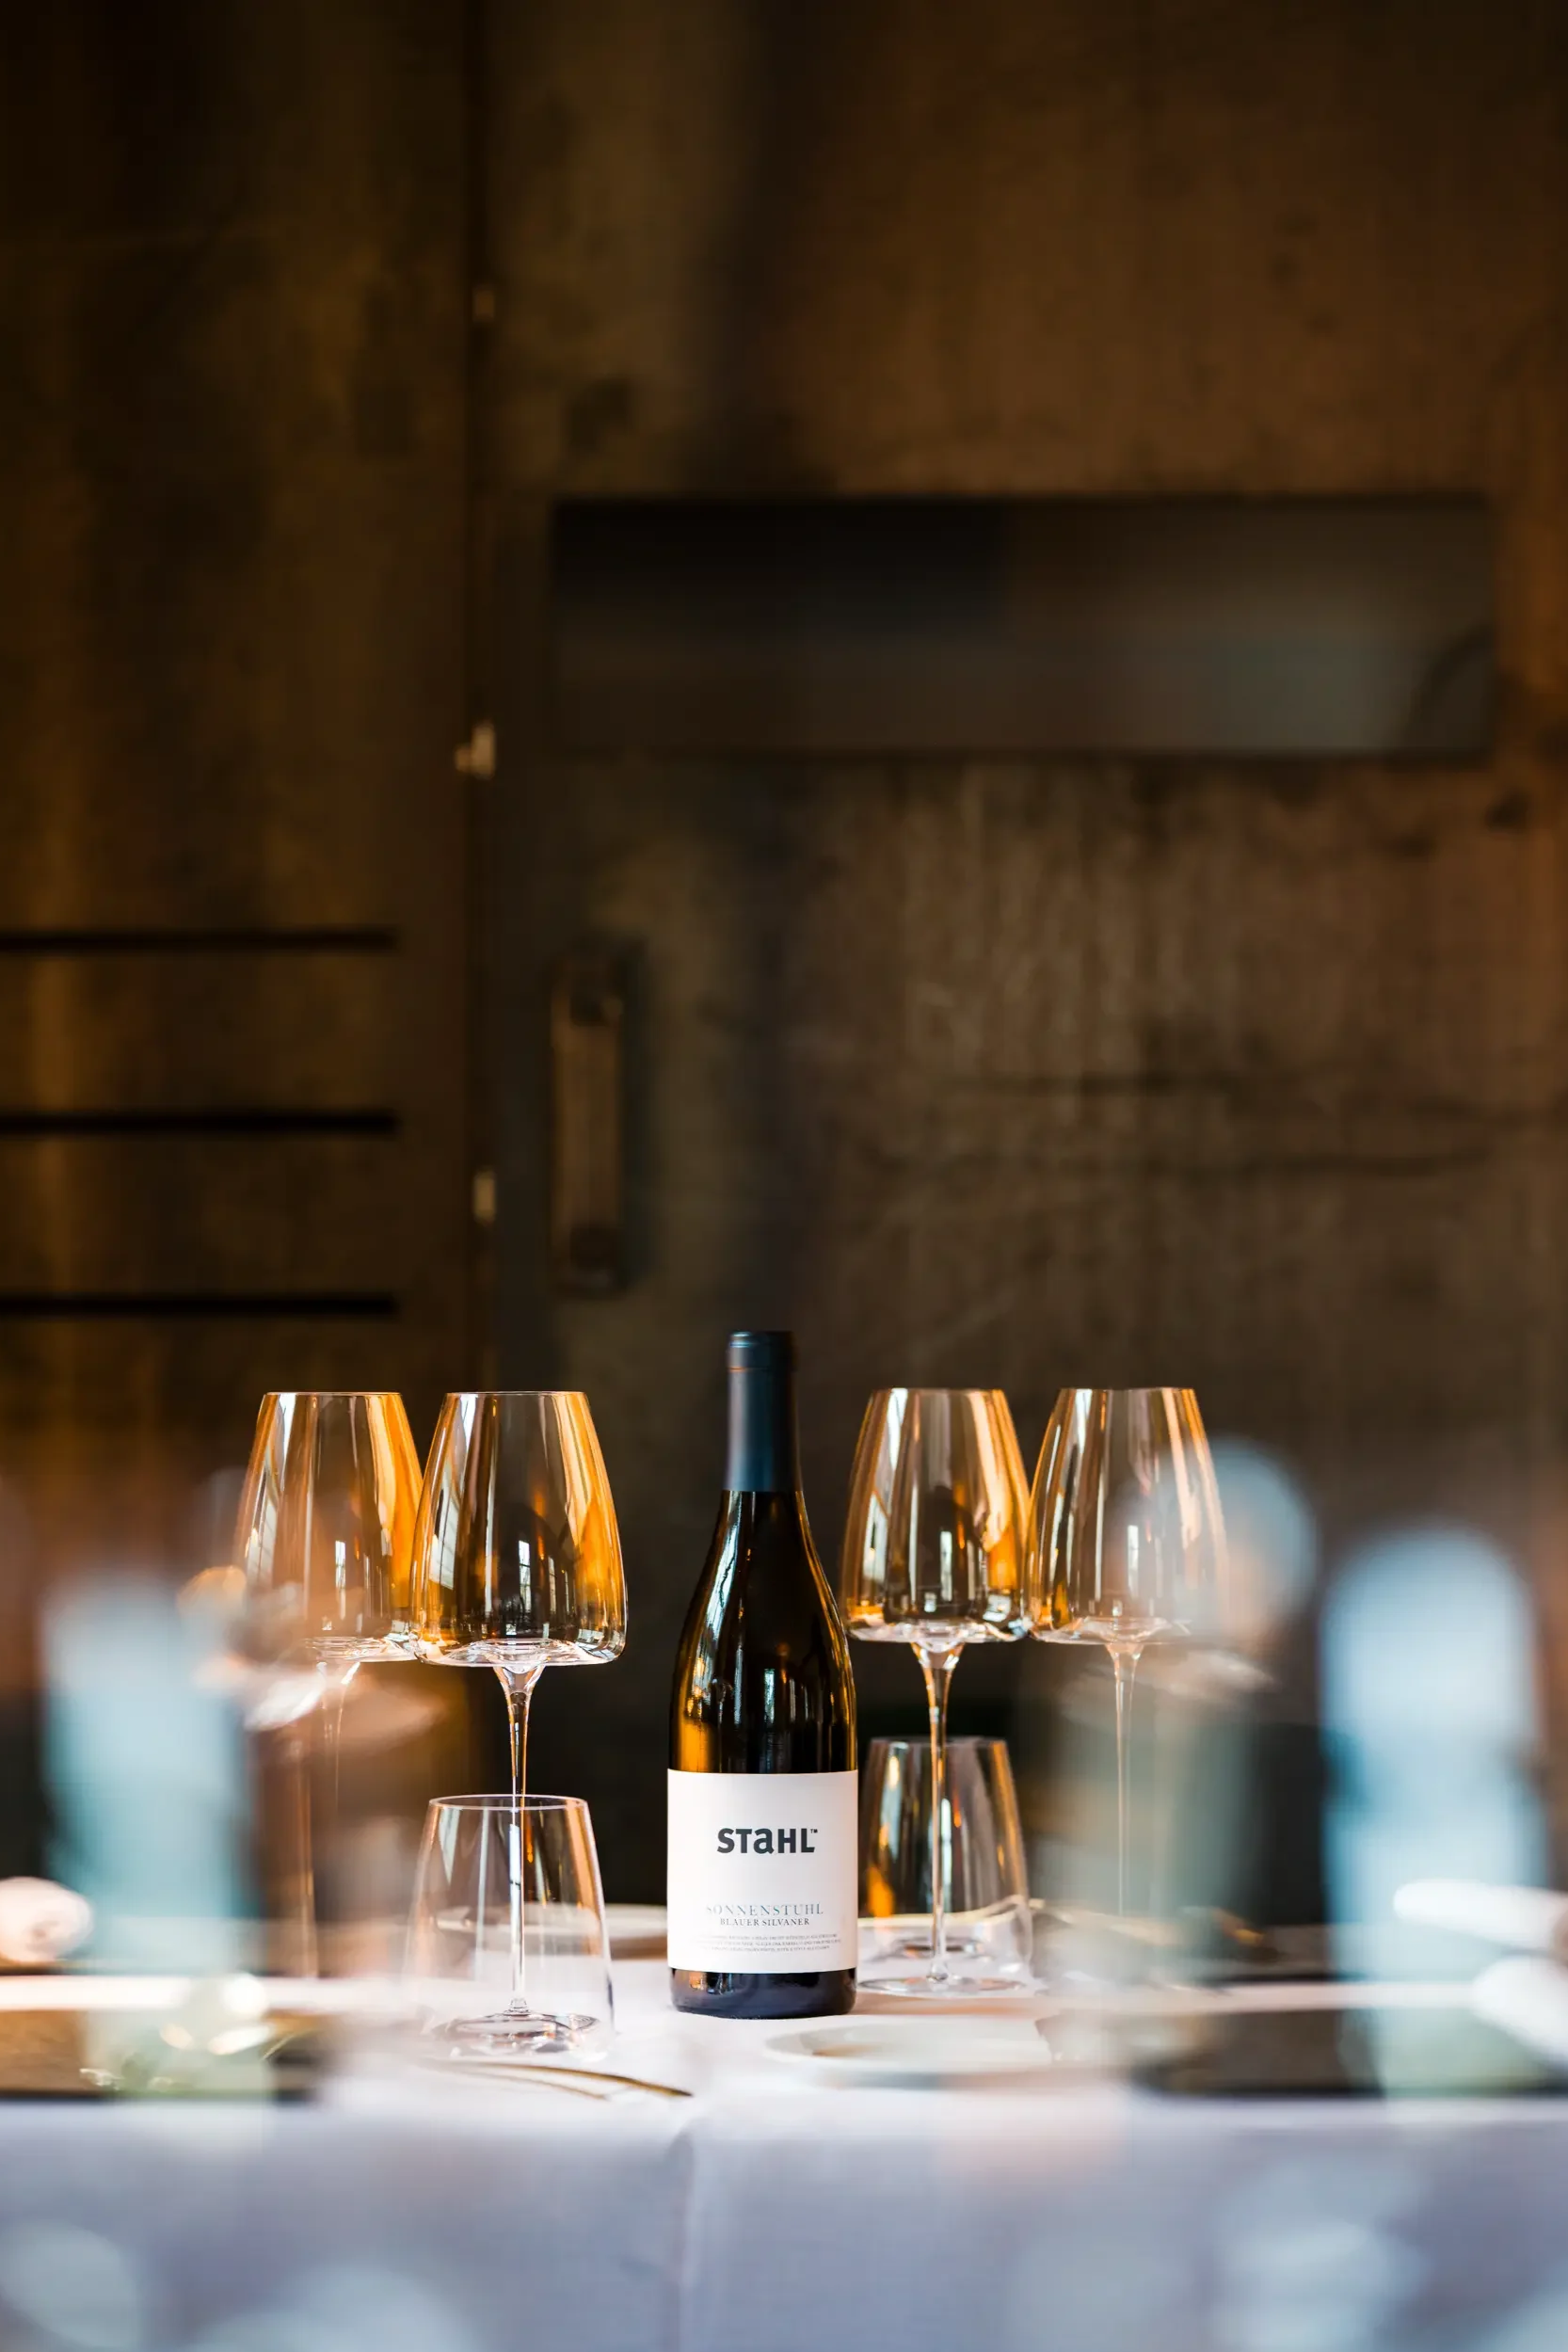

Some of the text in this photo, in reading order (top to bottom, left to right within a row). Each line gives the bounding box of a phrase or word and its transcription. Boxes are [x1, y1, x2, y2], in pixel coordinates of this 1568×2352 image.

[706, 1902, 824, 1916] SONNENSTUHL
[720, 1917, 810, 1927] BLAUER SILVANER
